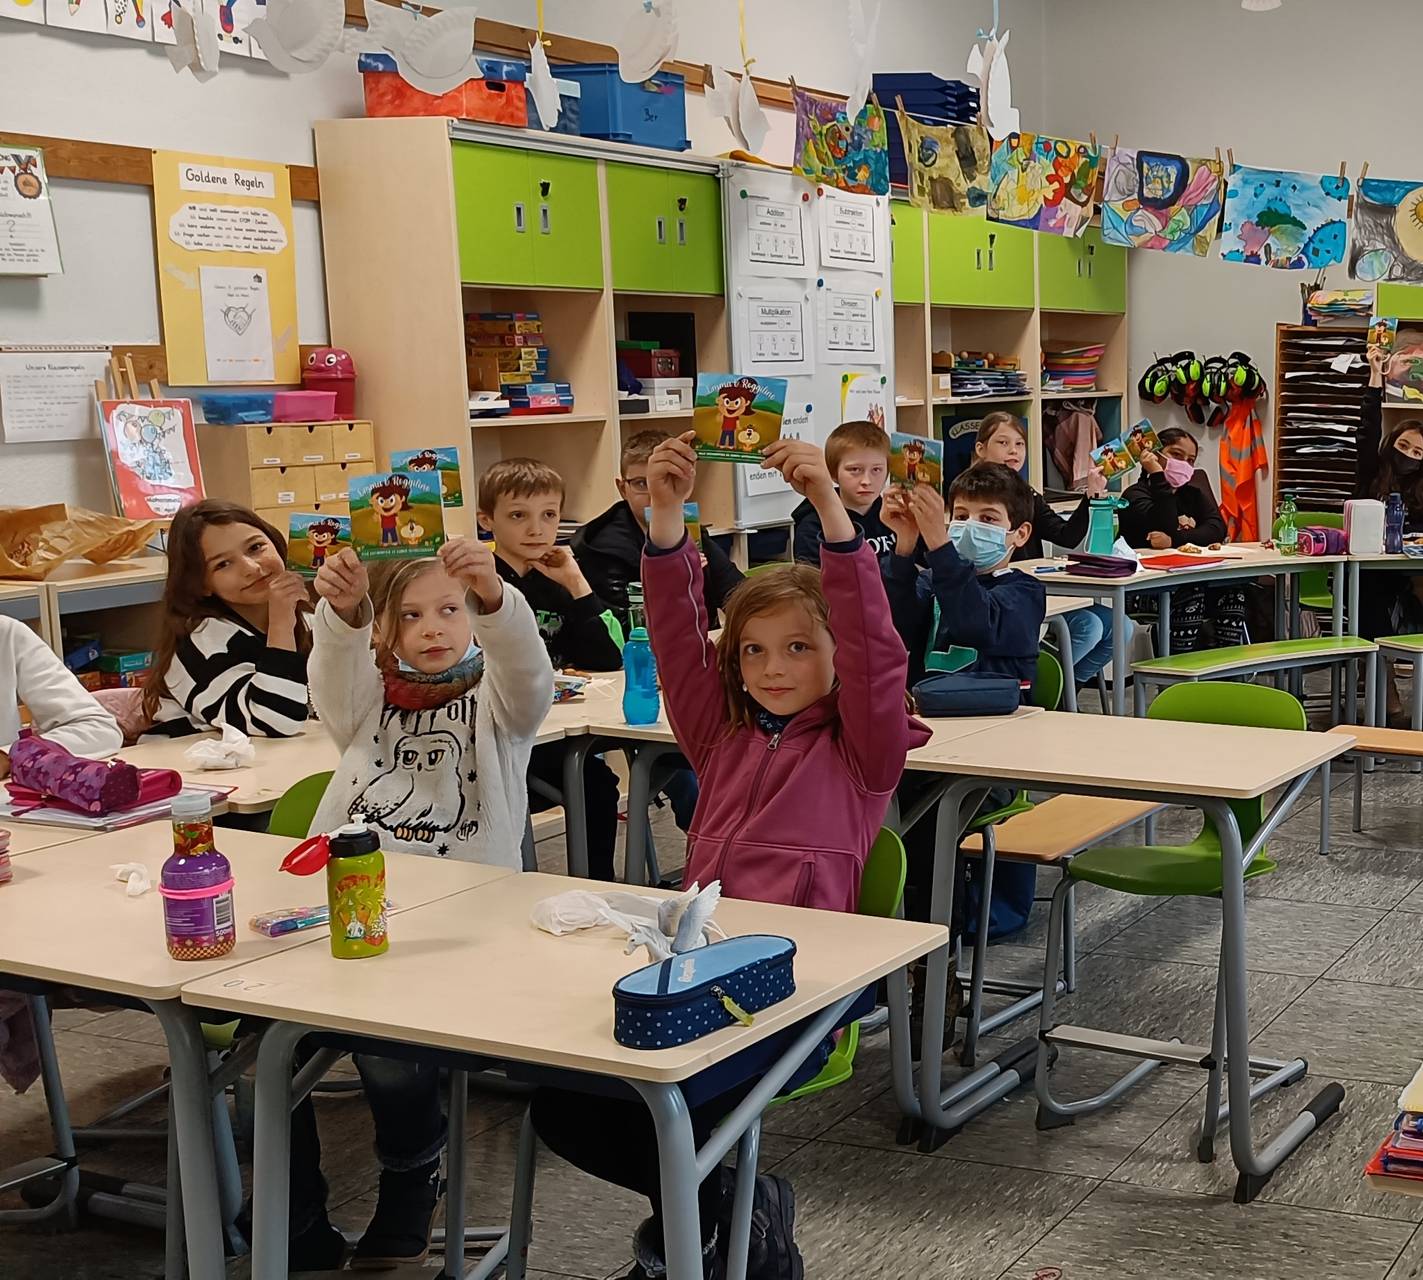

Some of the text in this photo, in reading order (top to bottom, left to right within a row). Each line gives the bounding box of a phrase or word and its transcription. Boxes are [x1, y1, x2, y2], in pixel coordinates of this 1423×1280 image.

[185, 167, 265, 191] Goldene Regeln
[749, 471, 768, 480] enden
